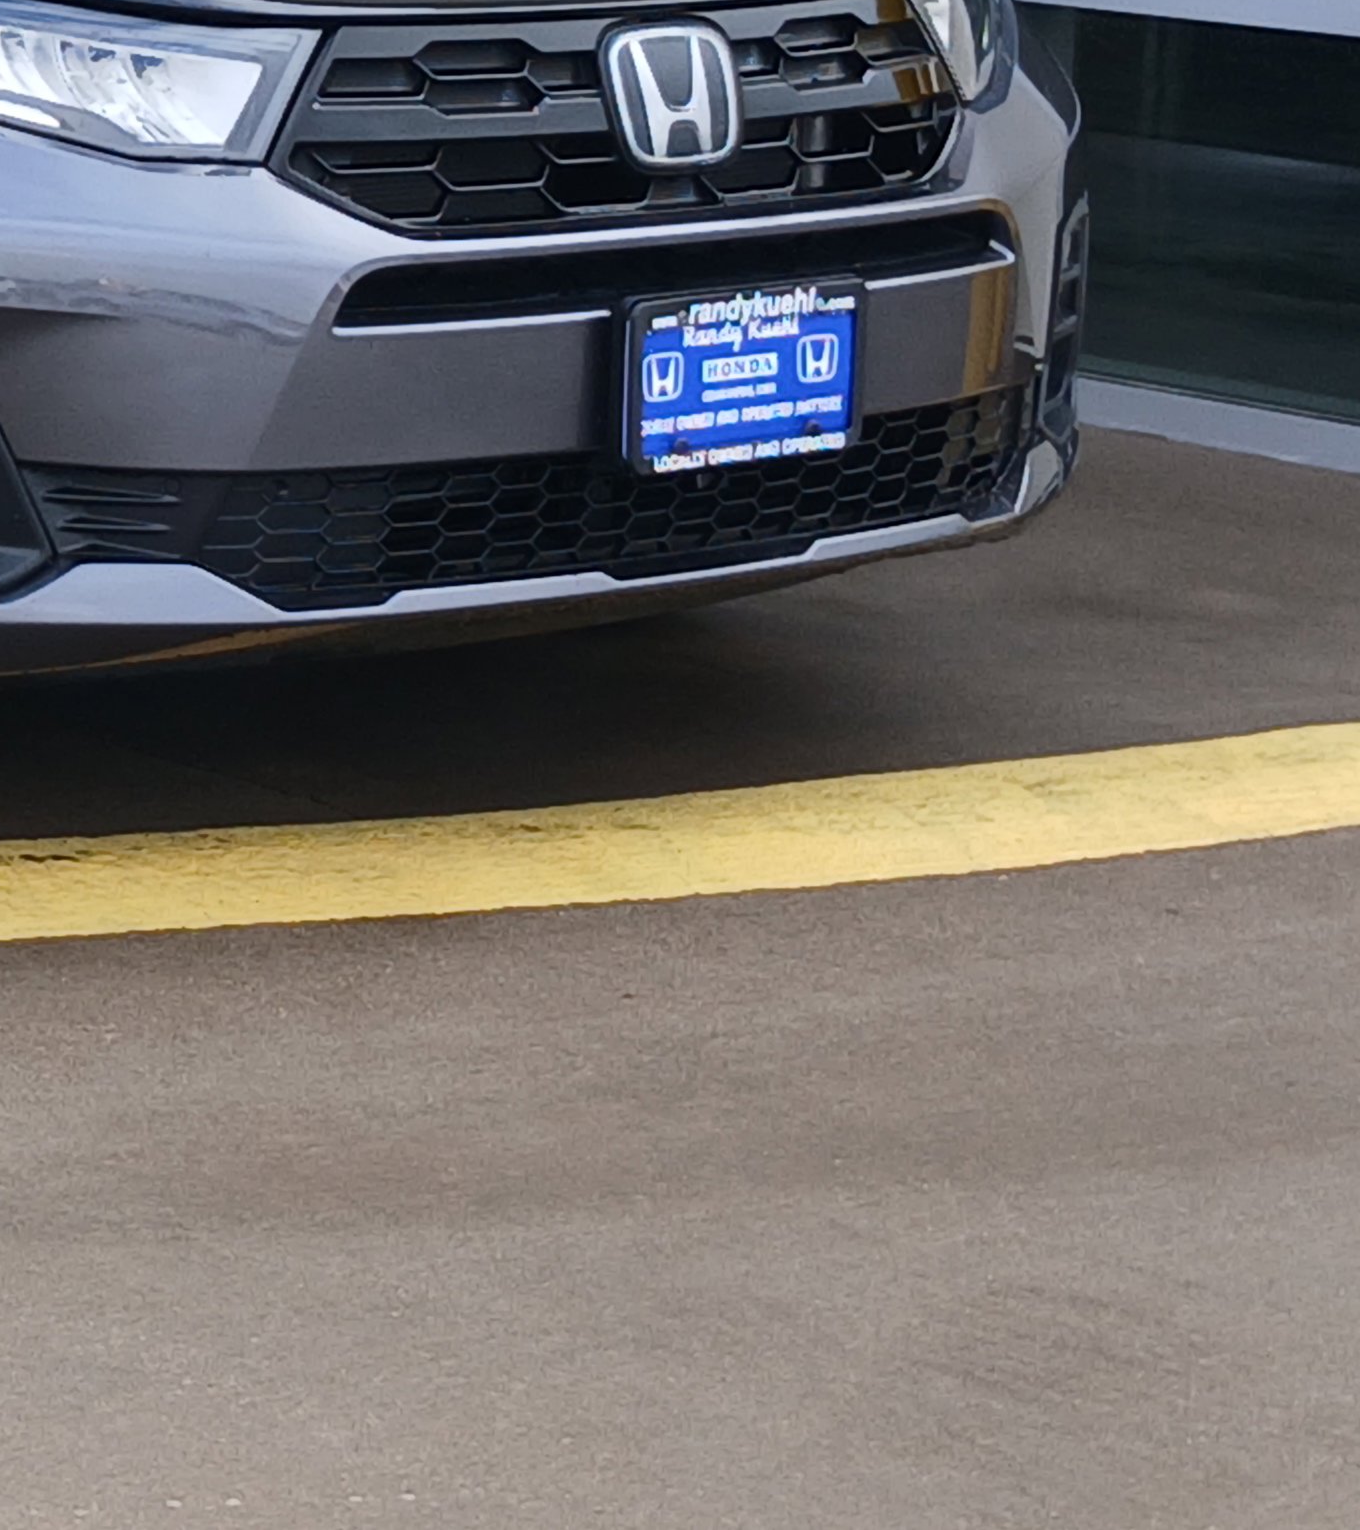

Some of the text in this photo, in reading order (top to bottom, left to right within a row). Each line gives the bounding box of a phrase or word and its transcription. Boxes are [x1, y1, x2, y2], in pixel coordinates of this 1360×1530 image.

[688, 286, 817, 326] randykuehl
[683, 325, 743, 352] Randy
[706, 357, 774, 379] HONDA
